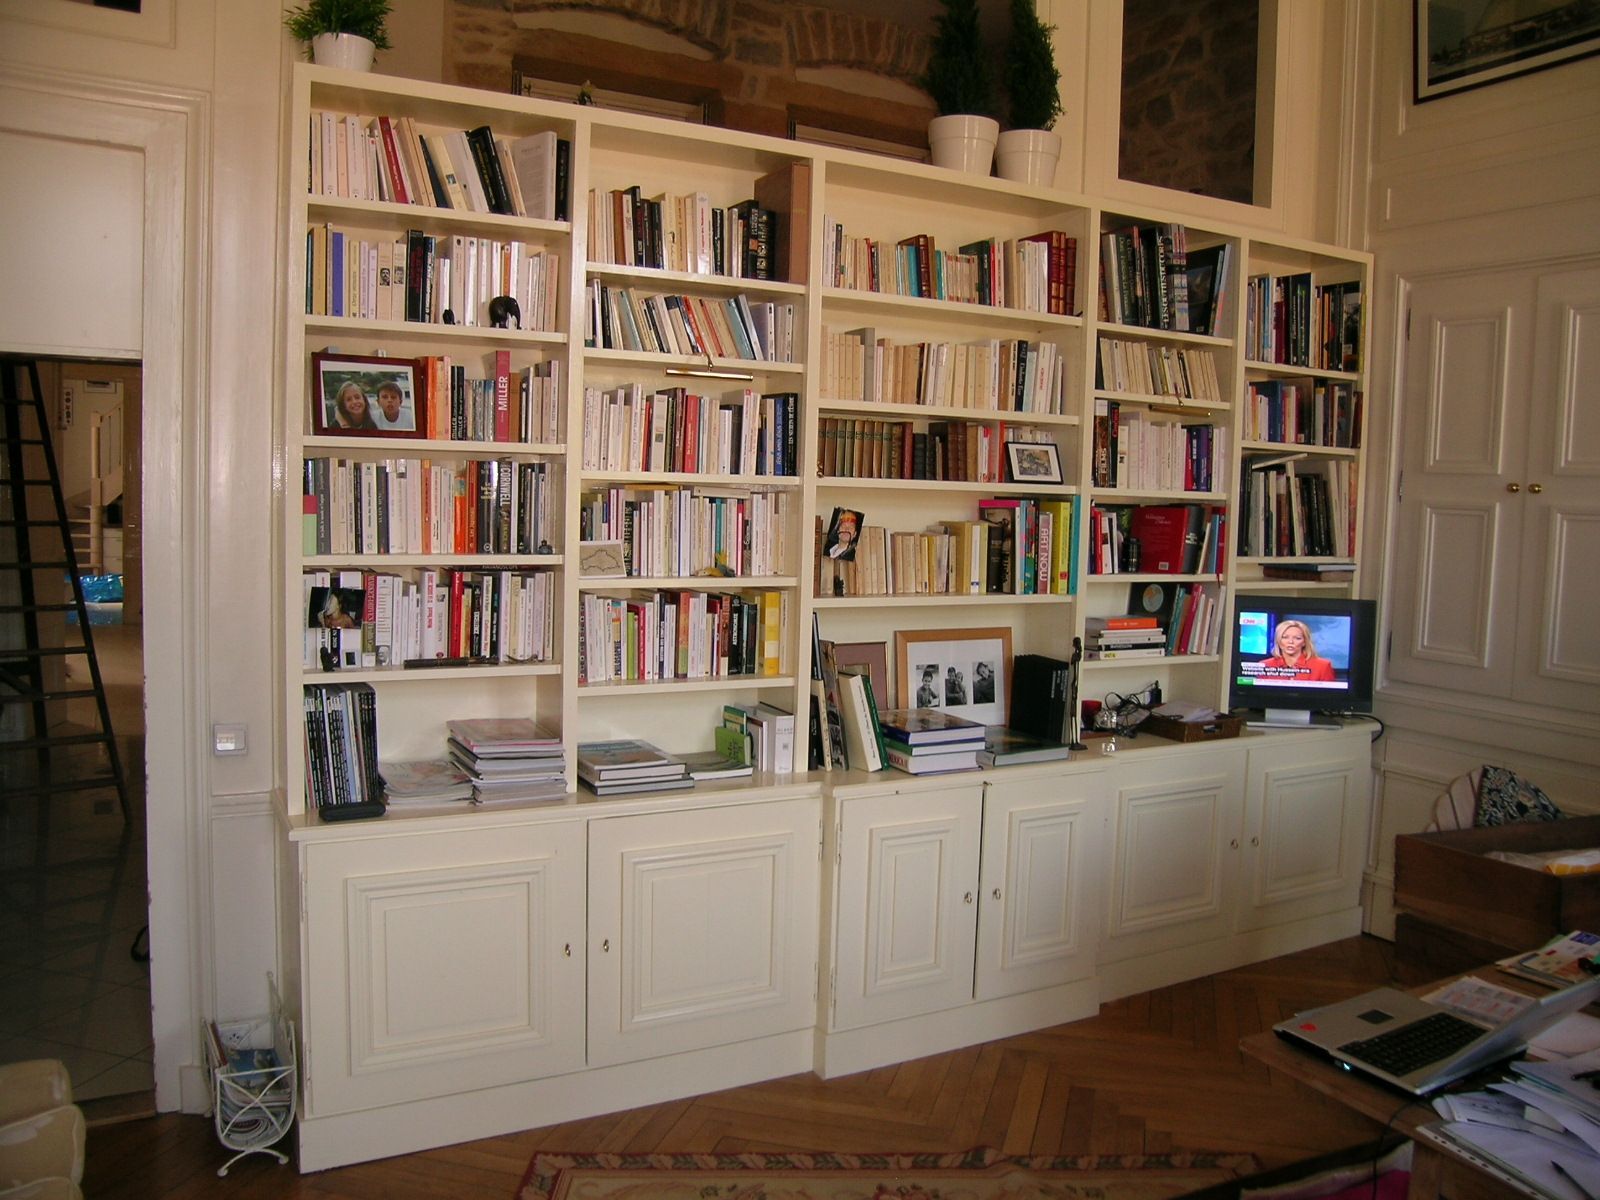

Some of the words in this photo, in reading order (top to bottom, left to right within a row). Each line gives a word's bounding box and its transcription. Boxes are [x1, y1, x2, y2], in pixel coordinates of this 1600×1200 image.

[498, 376, 508, 411] MILLER
[500, 468, 511, 506] CORNWELL
[1040, 529, 1049, 549] ART
[1040, 552, 1048, 581] NOW
[377, 586, 391, 633] Churchill
